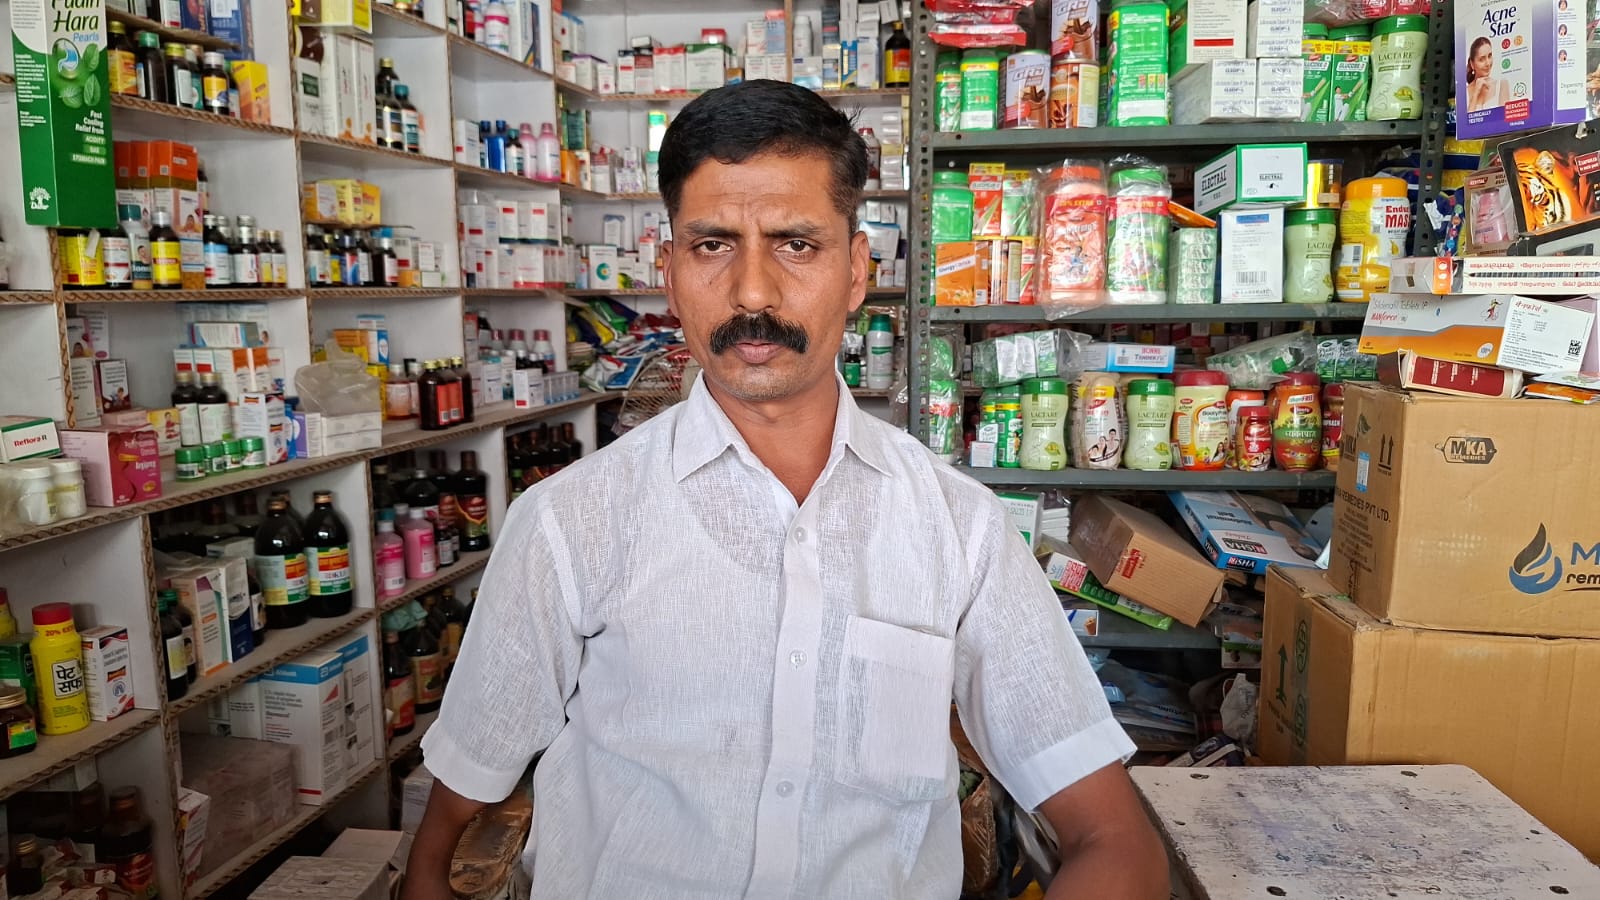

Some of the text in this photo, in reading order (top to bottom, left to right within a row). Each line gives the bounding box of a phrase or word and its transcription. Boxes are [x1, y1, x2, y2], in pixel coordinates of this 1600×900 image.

[53, 10, 99, 32] Hara
[1482, 6, 1517, 25] Acne
[73, 32, 99, 42] Pearls
[1489, 21, 1517, 38] Star
[1505, 101, 1529, 110] REDUCES
[1468, 110, 1492, 119] CLINICALLY
[1468, 117, 1484, 125] TESTED
[1201, 169, 1227, 192] ELECTRAL
[14, 437, 41, 447] Reflora
[1450, 440, 1486, 456] MKA
[1376, 508, 1391, 523] LTD.
[56, 664, 75, 680] पेट
